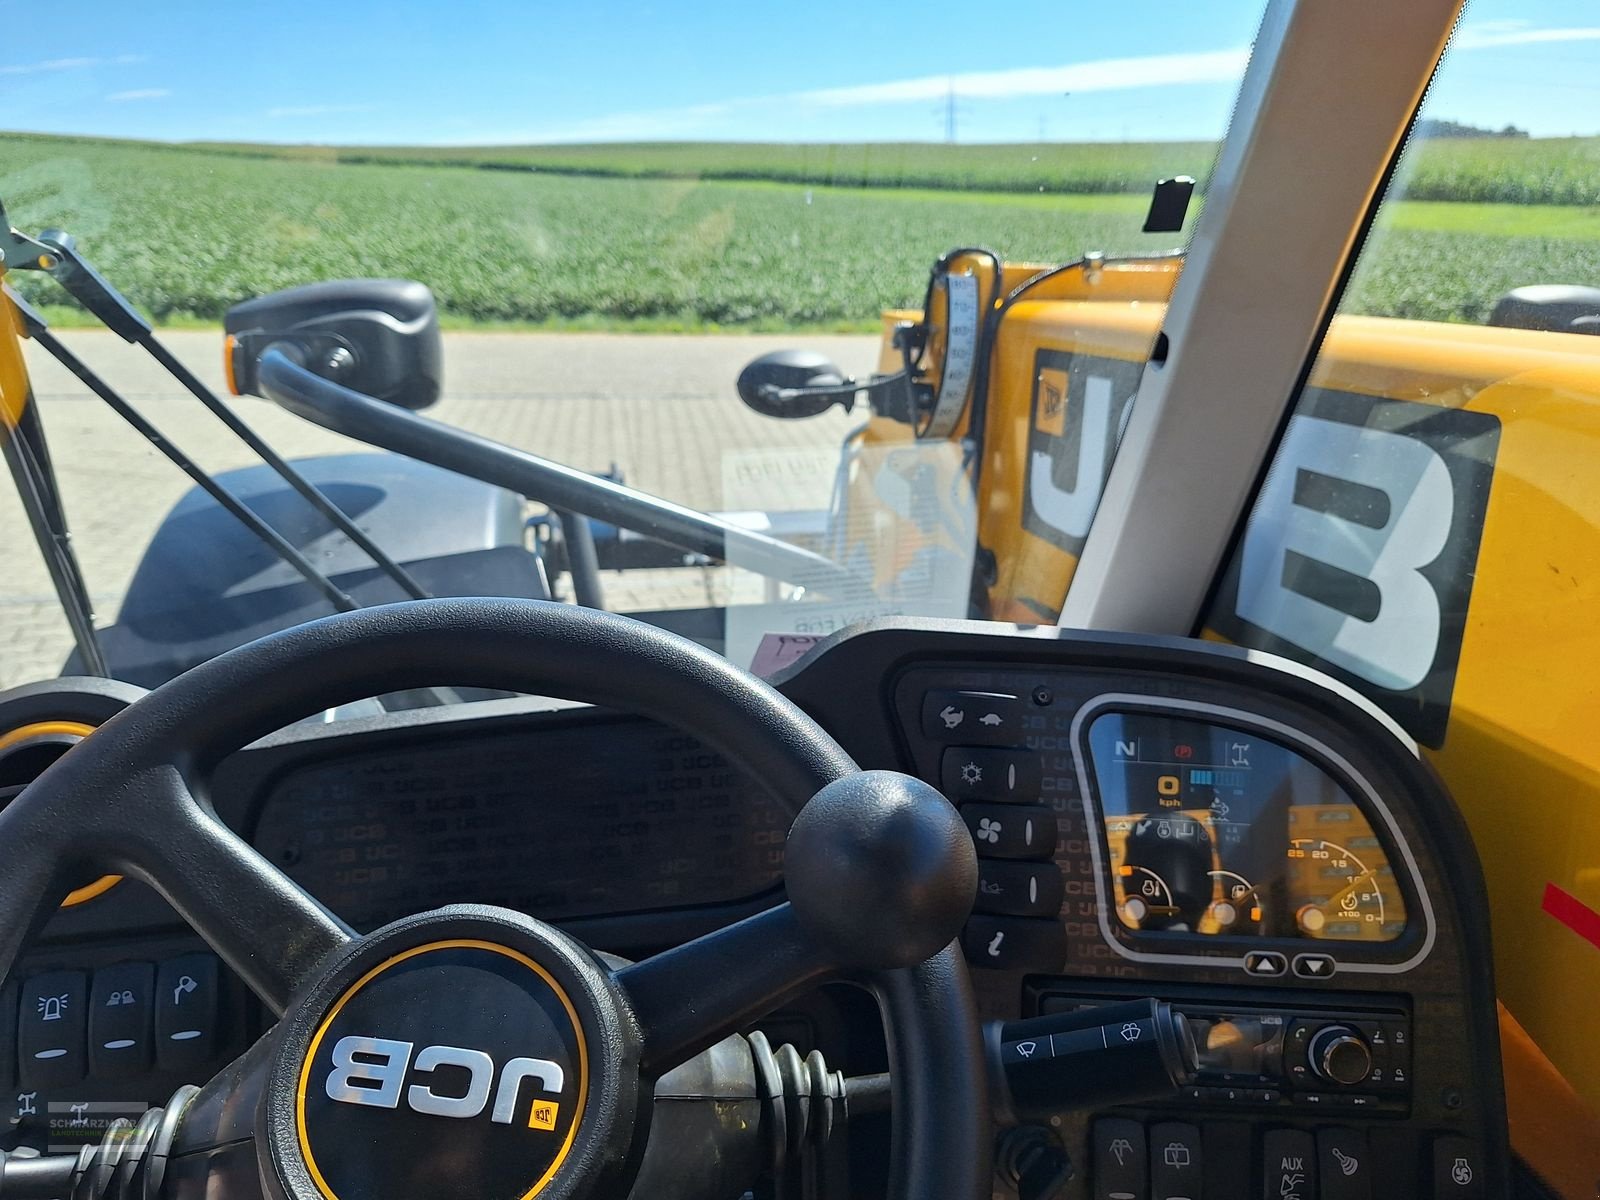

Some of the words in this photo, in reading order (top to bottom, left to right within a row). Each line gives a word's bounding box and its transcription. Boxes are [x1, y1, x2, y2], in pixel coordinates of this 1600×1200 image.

[1115, 740, 1136, 756] N
[1157, 775, 1180, 795] 0
[1159, 798, 1181, 808] kph
[1287, 849, 1305, 858] 25
[1311, 850, 1330, 859] 20
[1331, 859, 1347, 868] 15
[1361, 893, 1370, 901] 5
[1365, 914, 1375, 922] 0
[325, 1035, 564, 1125] JCB
[535, 1107, 551, 1124] JCB
[1281, 1157, 1304, 1170] AUX
